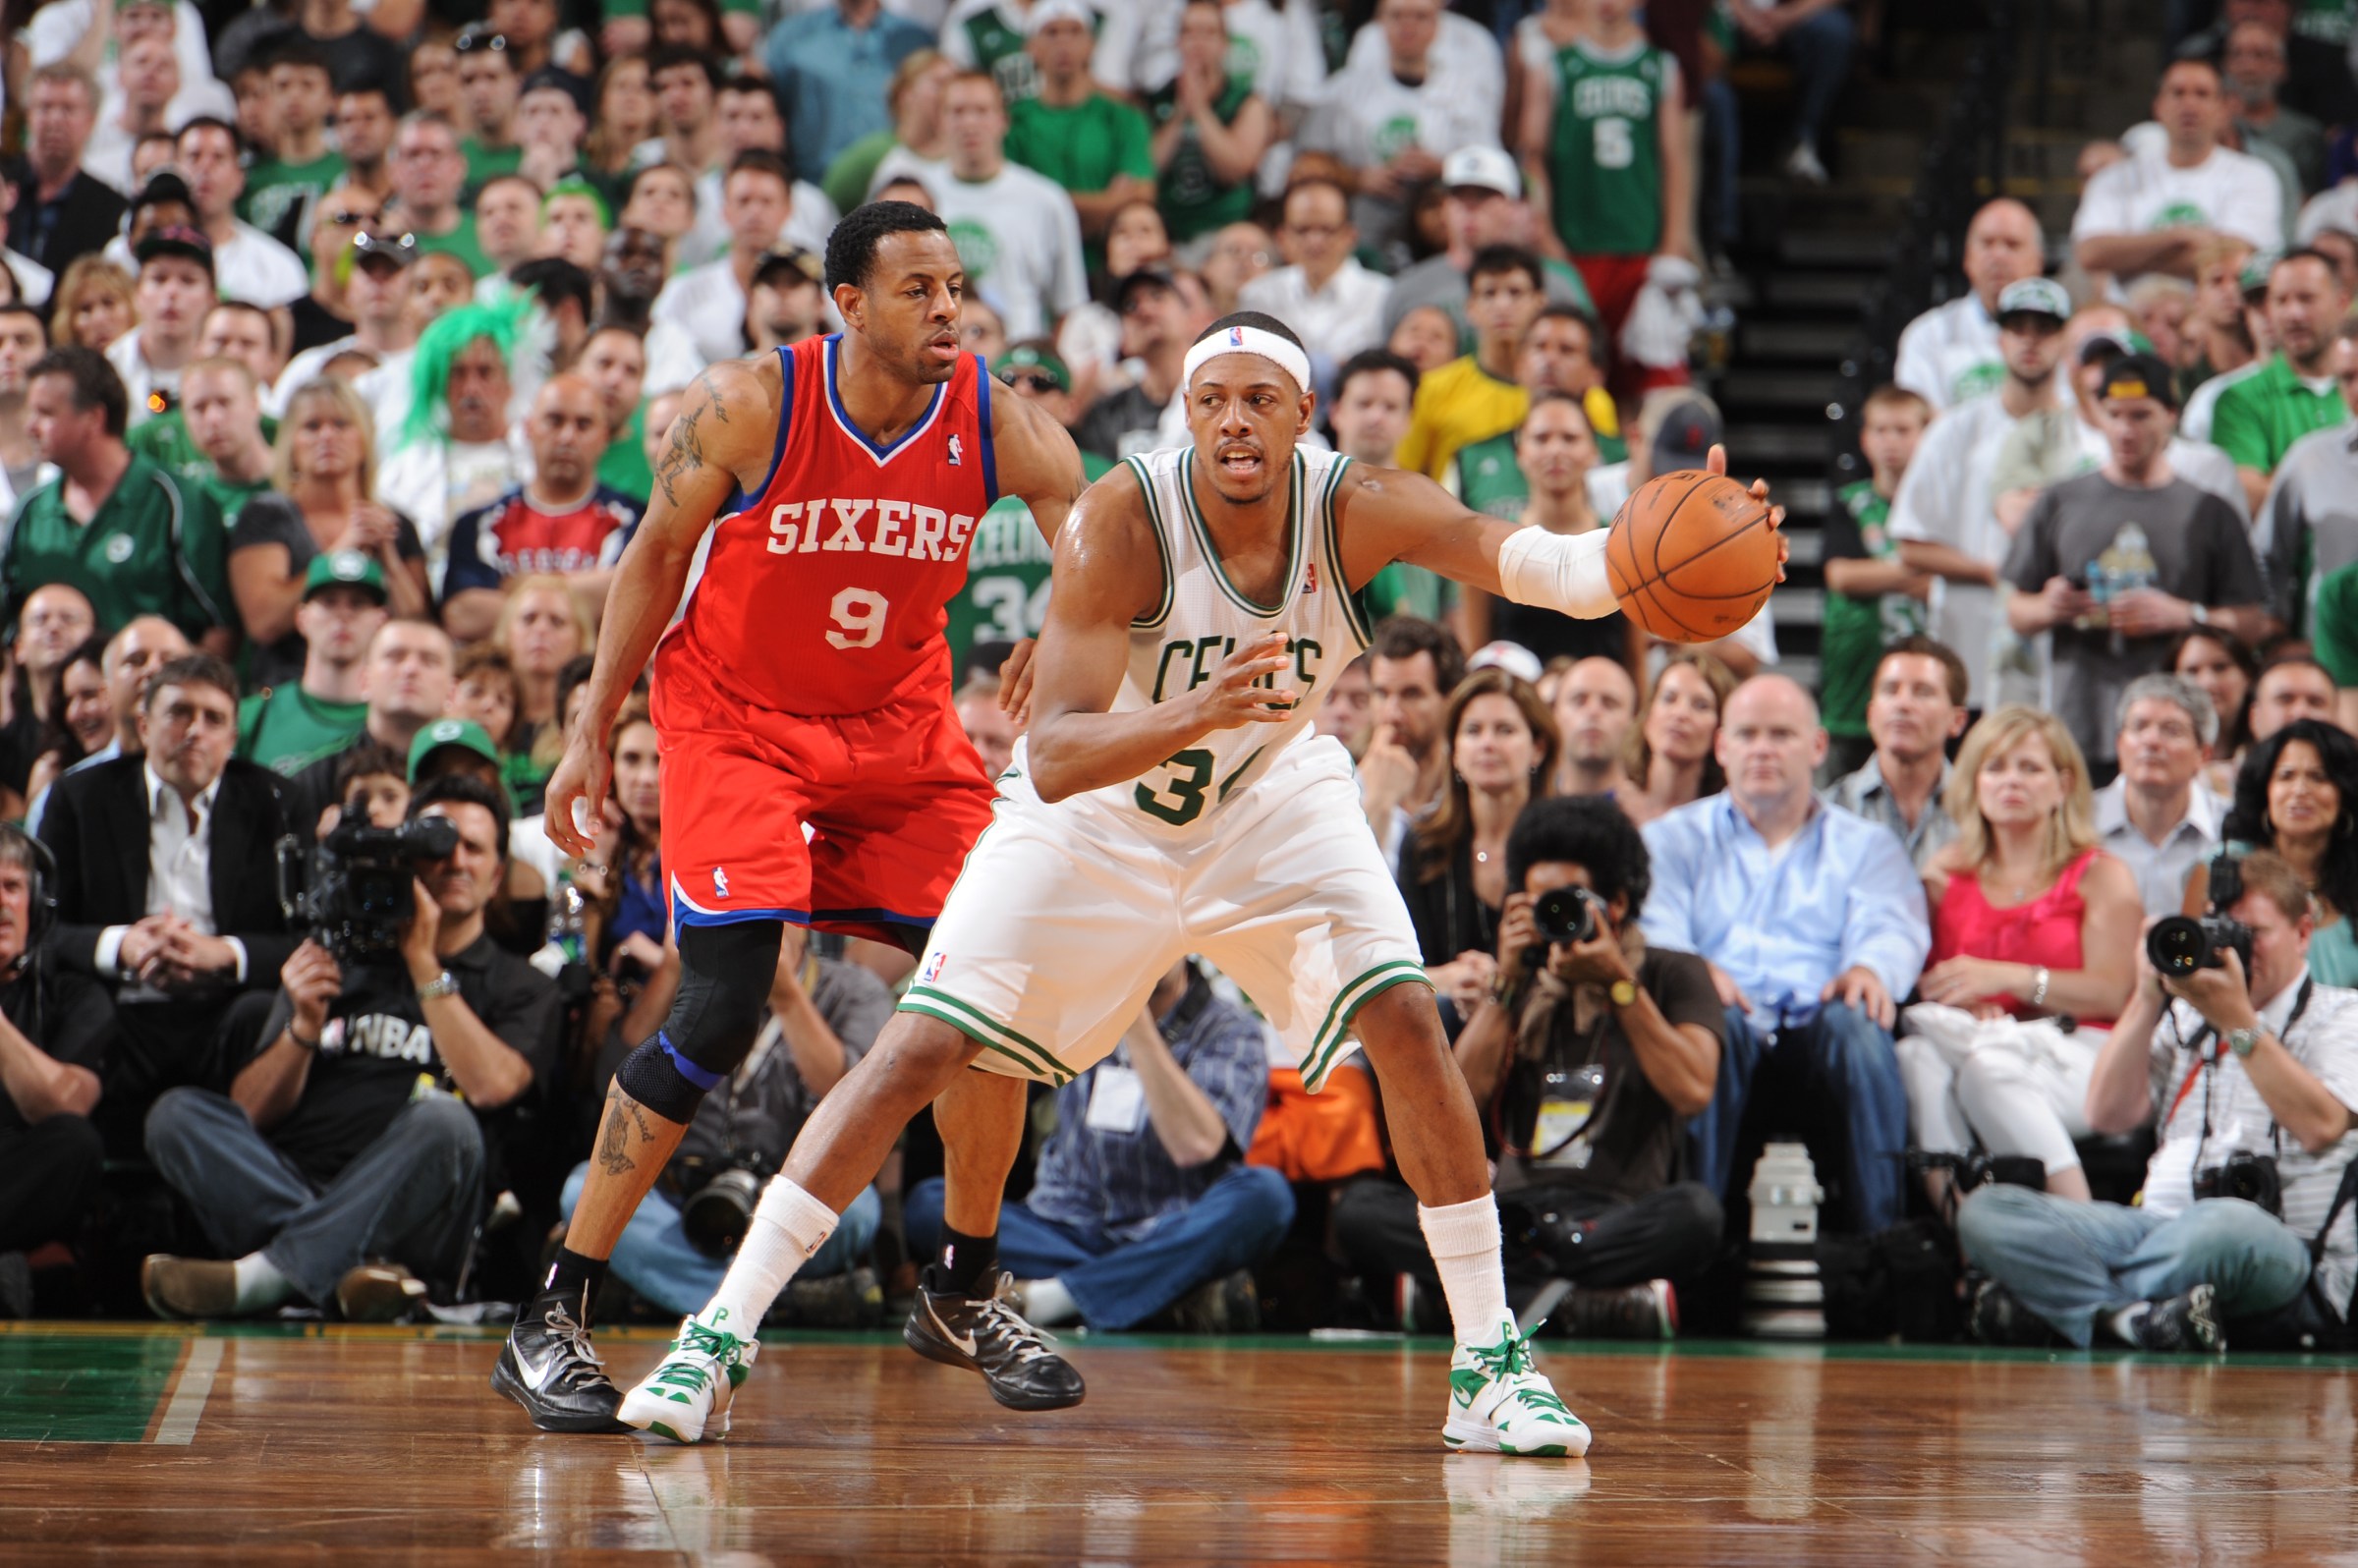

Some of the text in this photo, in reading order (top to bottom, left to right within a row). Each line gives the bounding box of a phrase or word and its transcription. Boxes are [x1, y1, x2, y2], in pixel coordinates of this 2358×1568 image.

[766, 498, 975, 562] SIXERS
[824, 587, 889, 650] 9
[1151, 630, 1322, 709] CECS
[351, 1012, 431, 1064] NBA
